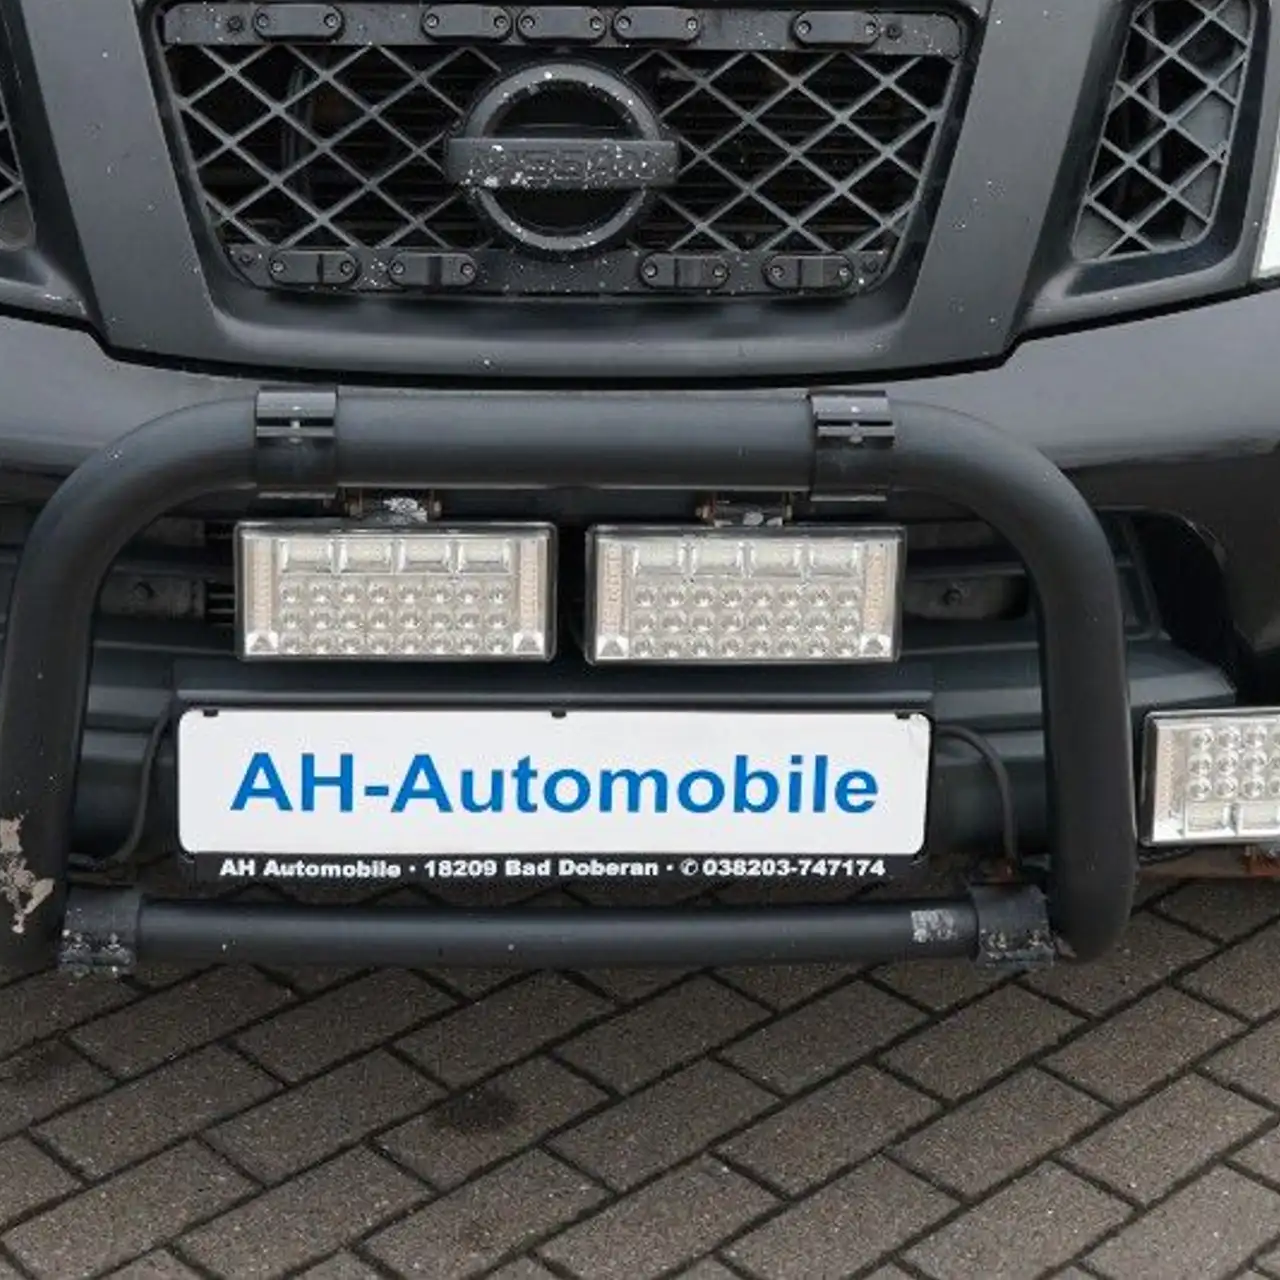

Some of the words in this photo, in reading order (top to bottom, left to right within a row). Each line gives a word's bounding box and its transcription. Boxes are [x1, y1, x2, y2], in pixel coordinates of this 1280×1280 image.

[230, 752, 879, 814] AH-Automobile
[220, 859, 256, 877] AH
[263, 859, 402, 879] Automobile
[424, 859, 498, 877] 18209
[505, 859, 551, 877] Bad
[559, 859, 659, 877] Doberan
[702, 858, 887, 877] 038203-747174
